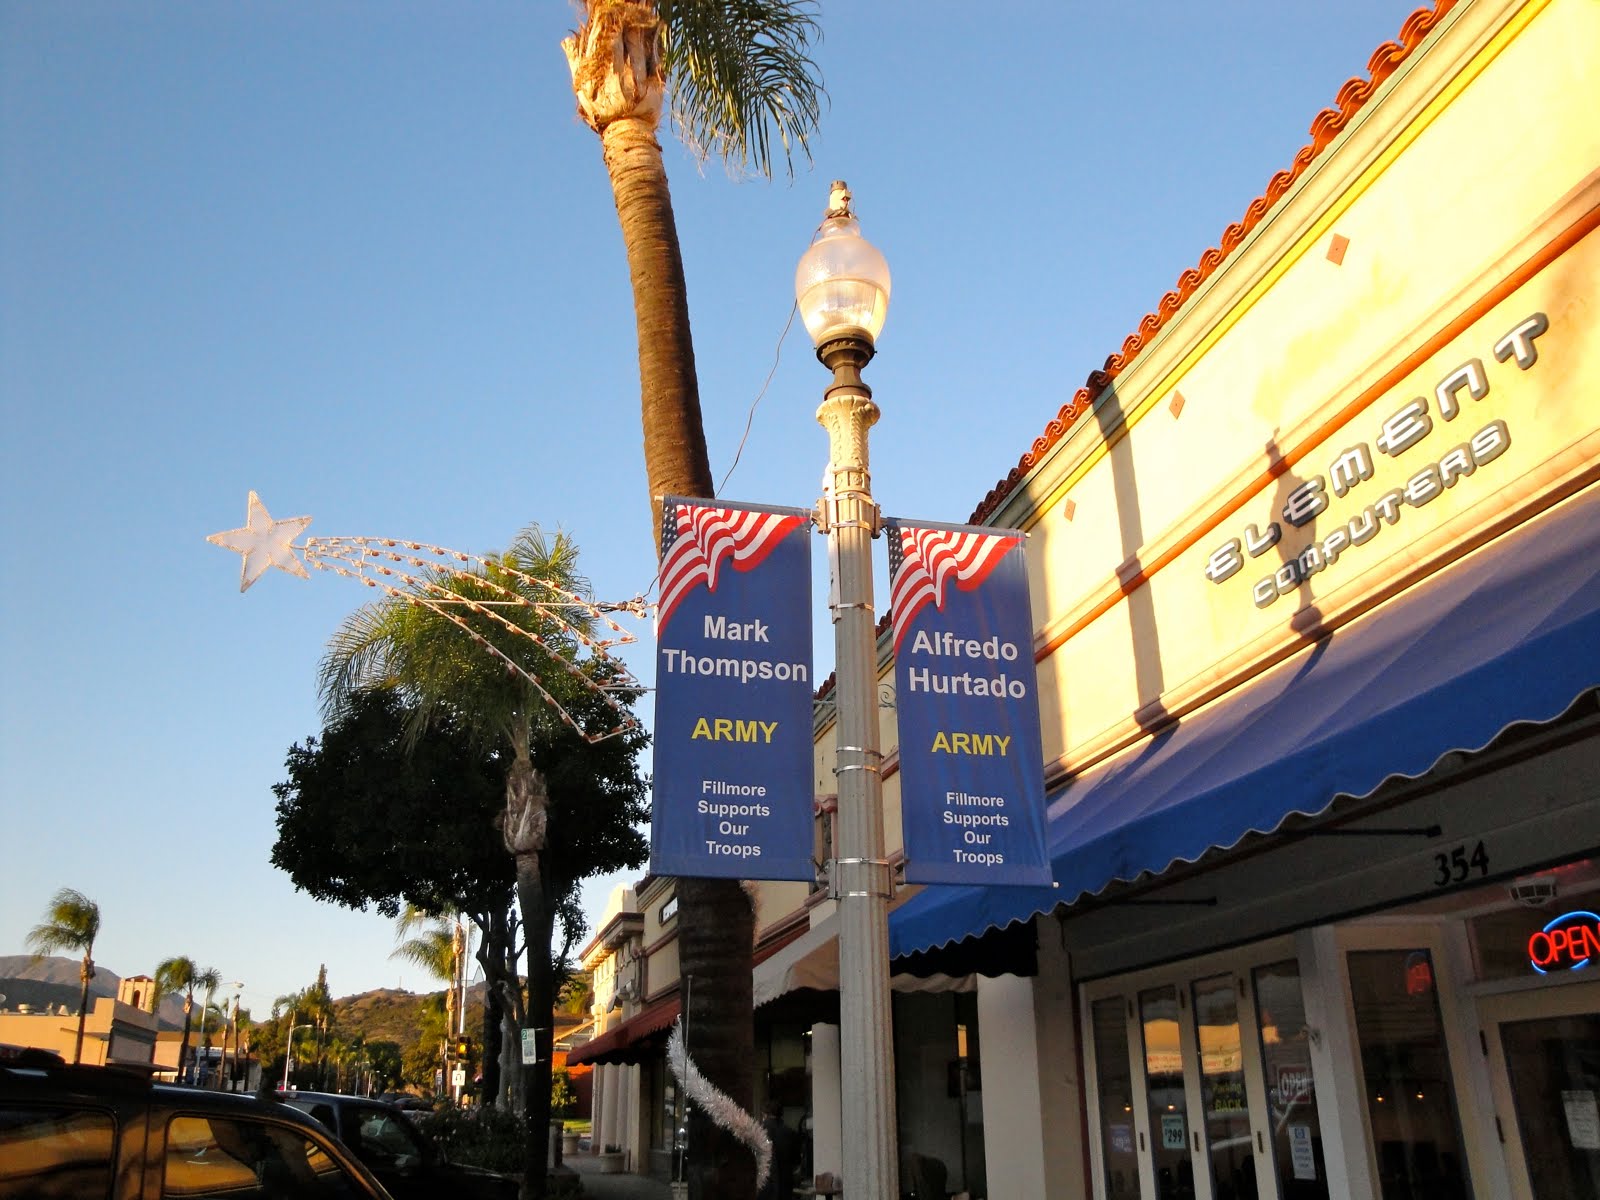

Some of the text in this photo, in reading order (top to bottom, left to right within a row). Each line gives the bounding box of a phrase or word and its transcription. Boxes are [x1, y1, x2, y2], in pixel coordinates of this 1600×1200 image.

[1205, 312, 1549, 584] ELEMENT
[1252, 419, 1511, 608] COMPUTERS
[704, 615, 769, 643] Mark
[911, 630, 1018, 661] Alfredo
[662, 648, 808, 684] Thompson
[909, 667, 1026, 699] Hurtado
[691, 717, 778, 744] ARMY
[931, 731, 1011, 757] ARMY
[702, 780, 767, 797] Fillmore
[946, 791, 1005, 807] Fillmore
[697, 800, 771, 817] Supports
[943, 810, 1009, 827] Supports
[719, 820, 749, 836] Our
[964, 830, 991, 845] Our
[705, 840, 762, 857] Troops
[953, 849, 1004, 865] Troops
[1434, 840, 1489, 886] 354
[1528, 924, 1600, 965] OPEN
[1281, 1071, 1310, 1097] OPEN
[1215, 1098, 1243, 1113] BACK
